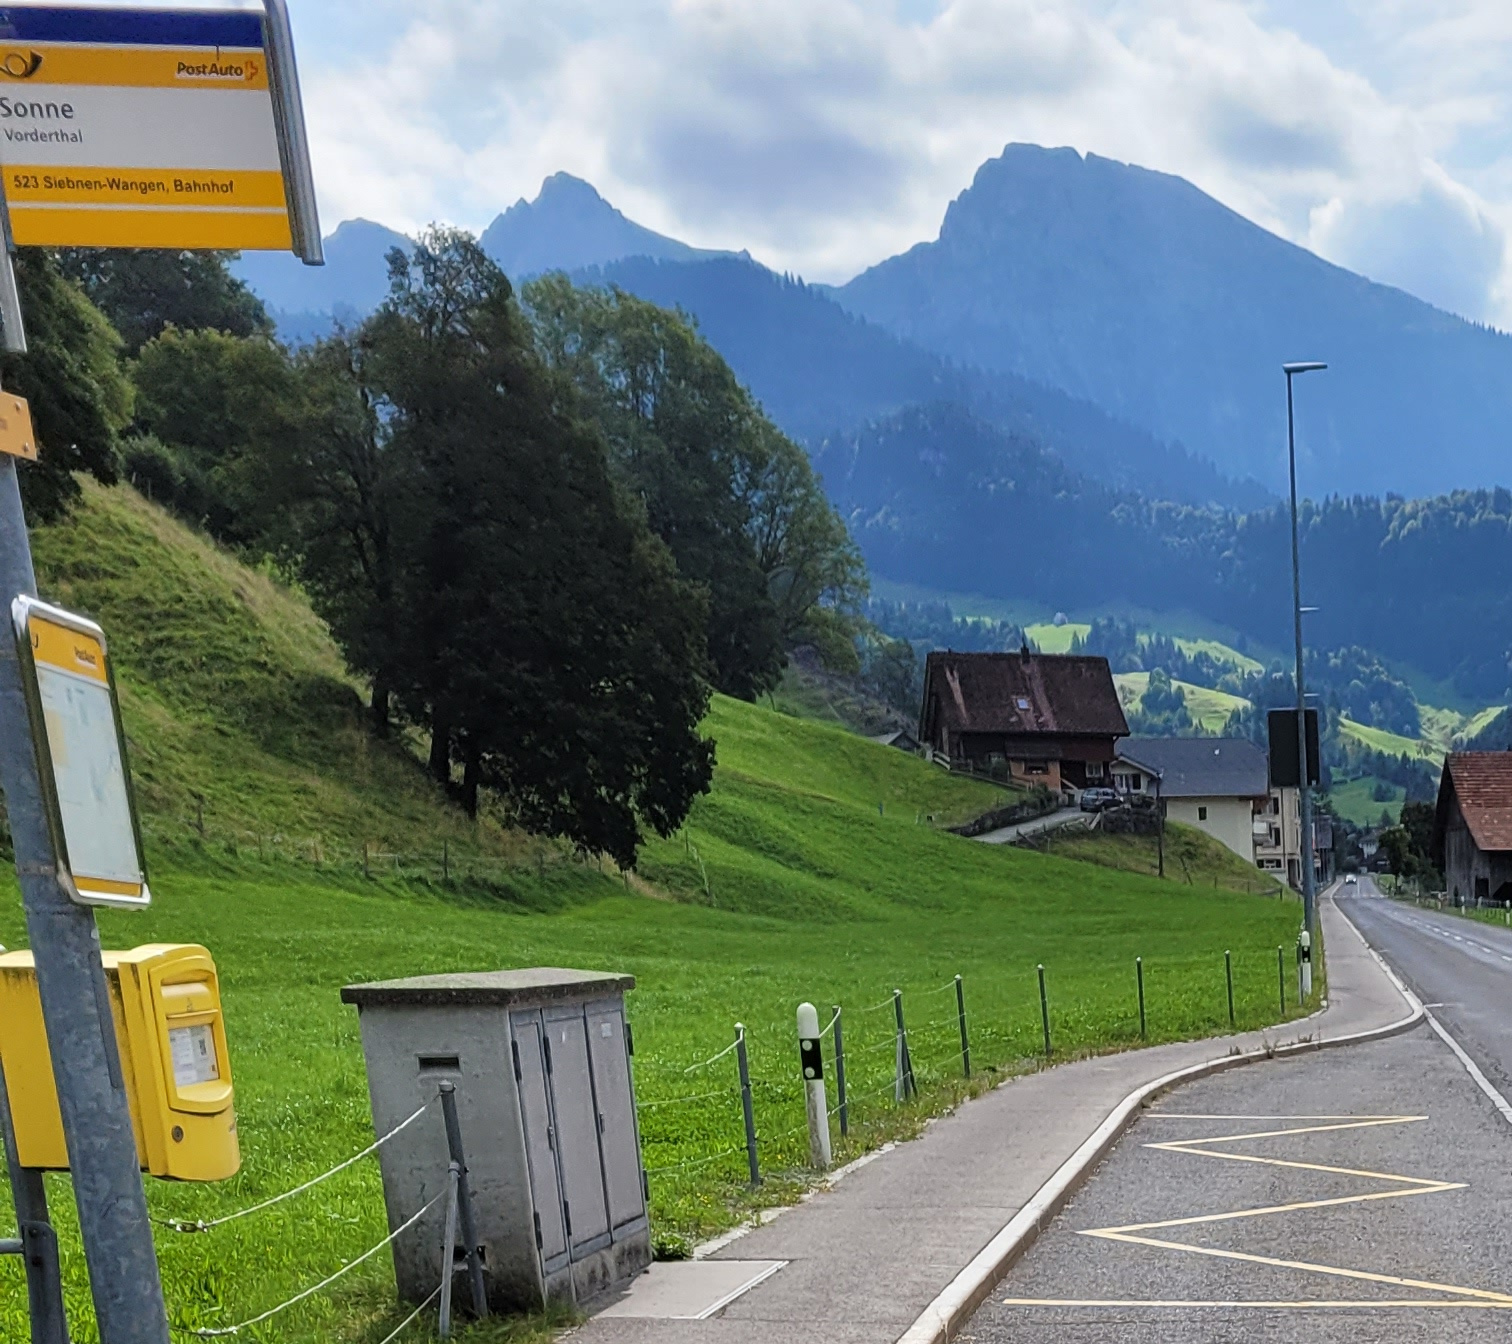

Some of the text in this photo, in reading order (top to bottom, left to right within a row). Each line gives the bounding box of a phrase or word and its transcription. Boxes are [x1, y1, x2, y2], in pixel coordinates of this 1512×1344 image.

[177, 61, 244, 77] PostAuto
[0, 96, 74, 119] Sonne
[3, 127, 83, 143] Vorderthal
[13, 174, 234, 195] 523 Siebnen-Wangen, Bahnhof
